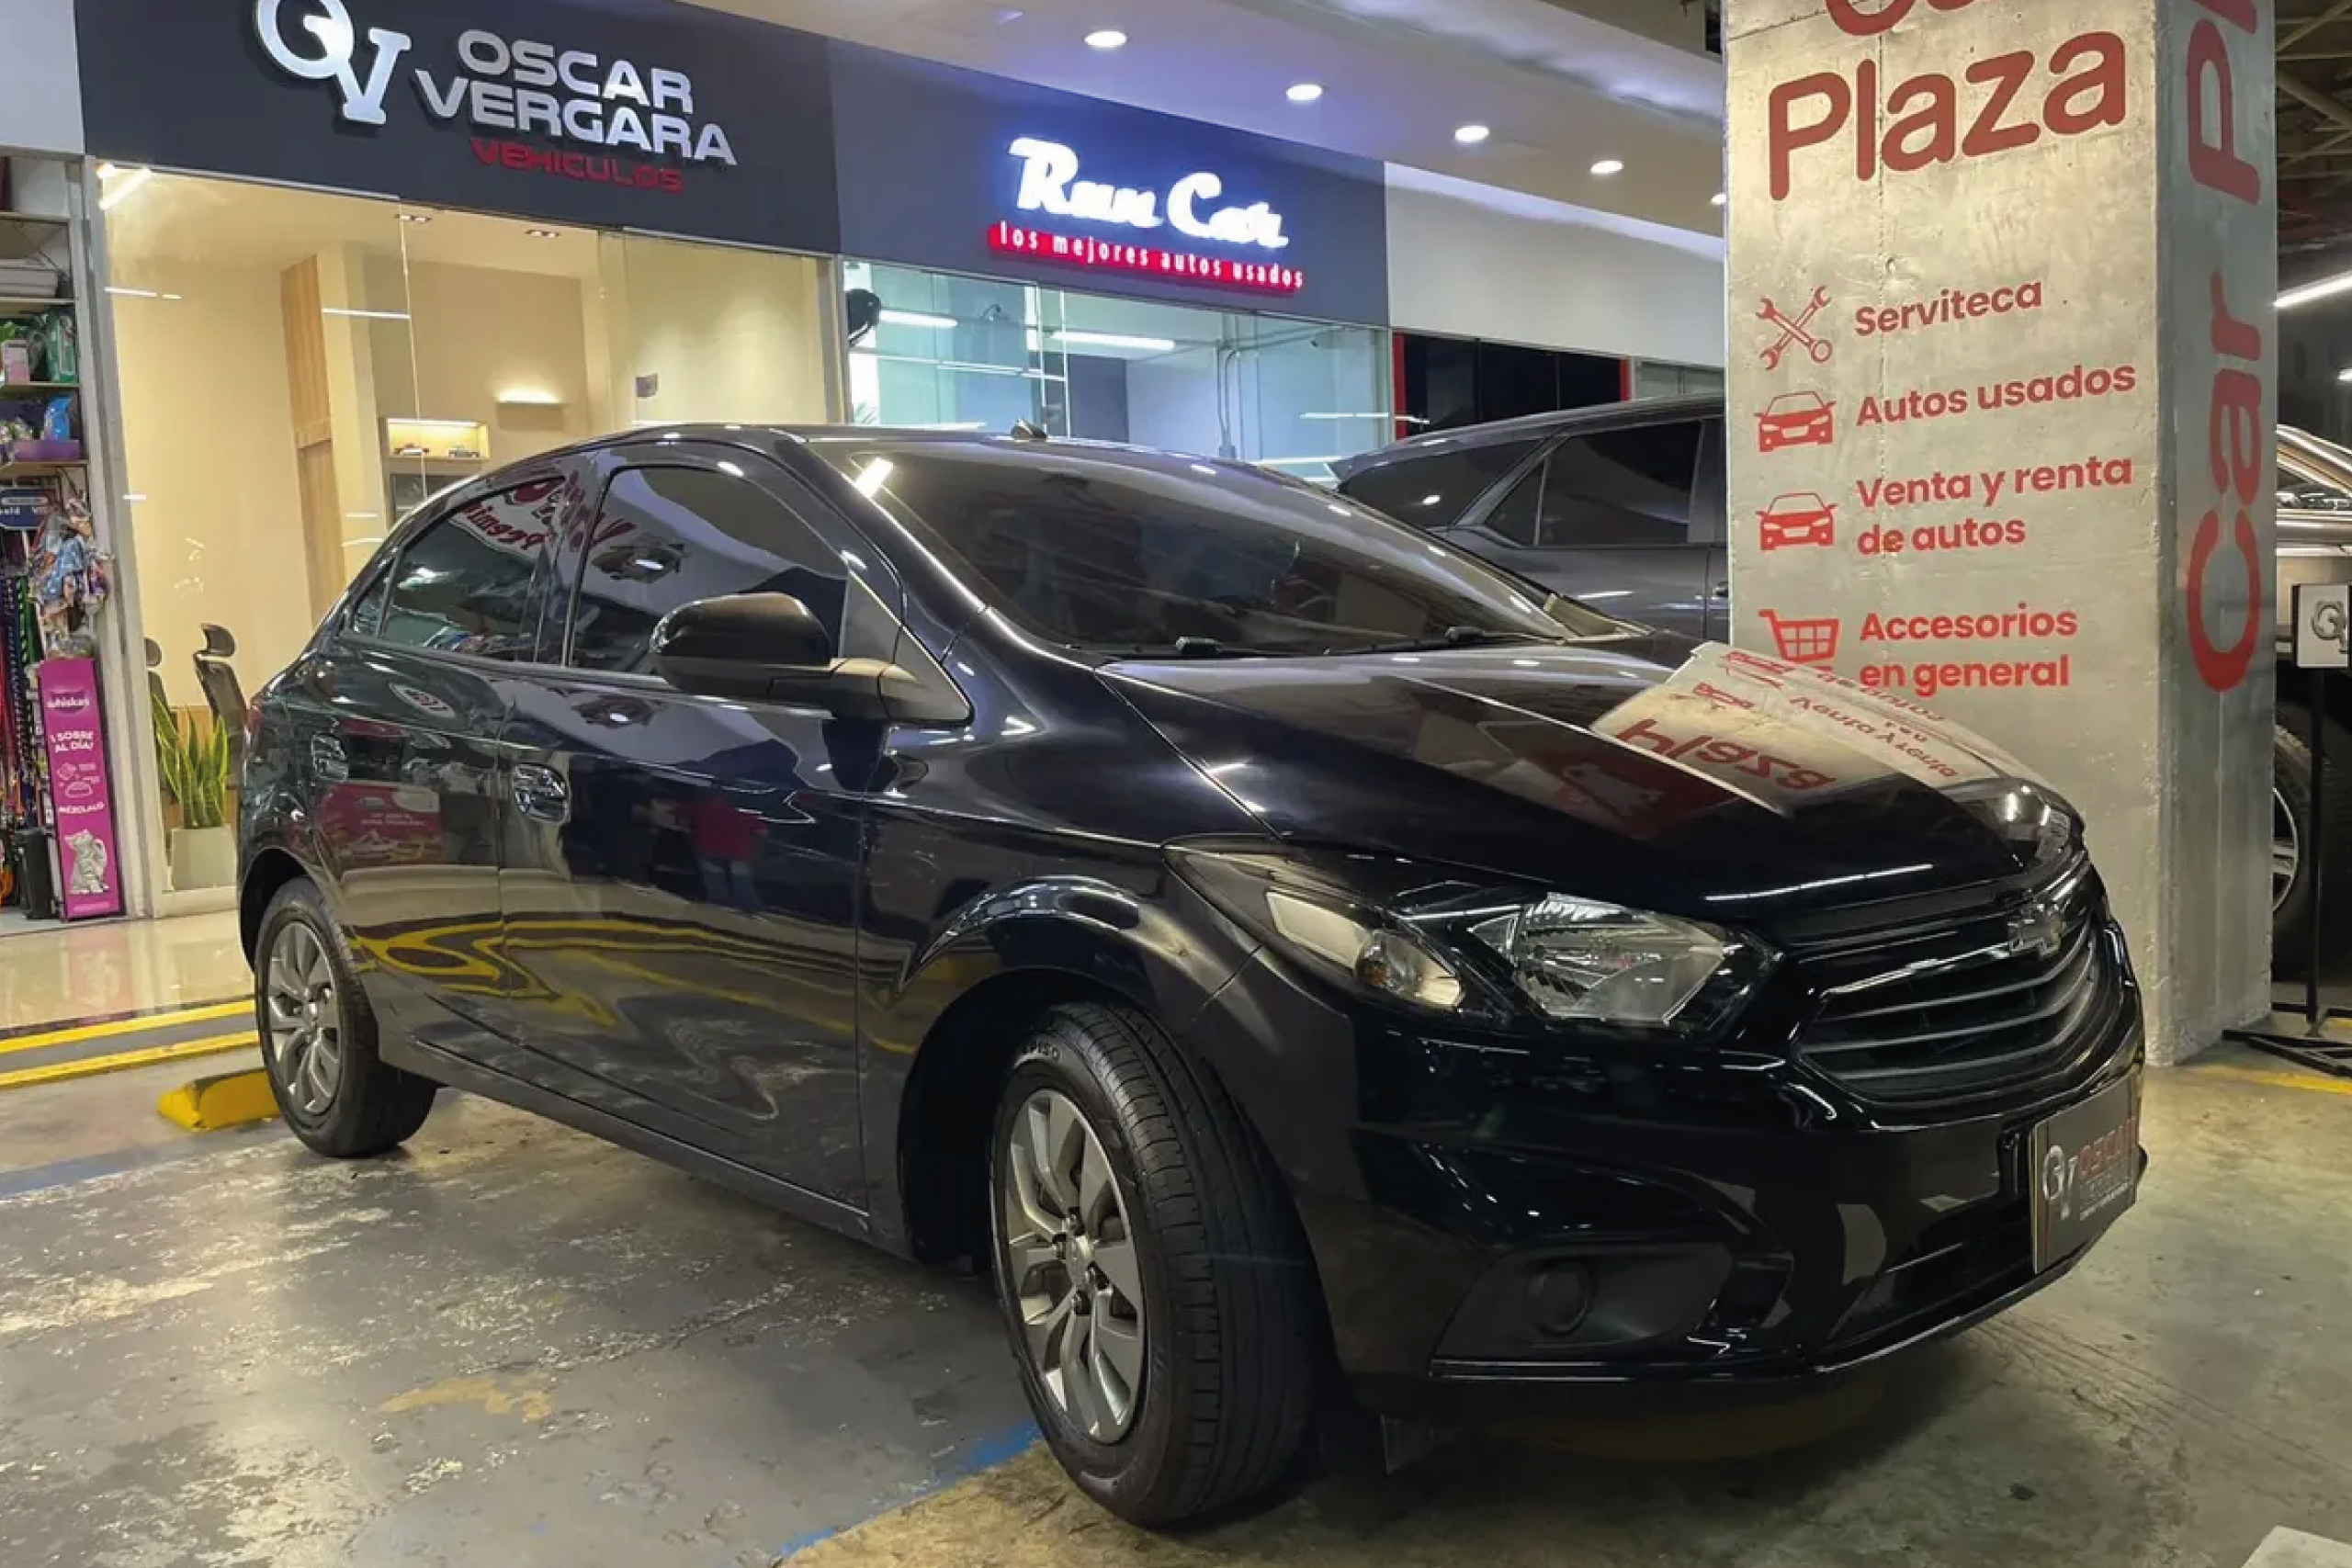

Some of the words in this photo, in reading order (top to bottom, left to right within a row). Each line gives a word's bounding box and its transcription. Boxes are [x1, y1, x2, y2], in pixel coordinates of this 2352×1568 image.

[458, 28, 693, 114] OSCAR
[414, 68, 737, 165] VERGARA
[1769, 30, 2126, 201] Plaza
[1009, 137, 1163, 229] Run
[1167, 172, 1289, 248] Car
[1000, 220, 1039, 251] los
[1053, 235, 1148, 265] mejores
[1160, 253, 1222, 276] autos
[1233, 263, 1303, 289] usados
[1854, 280, 2042, 336] Serviteca
[1856, 388, 1969, 426] Autos
[1976, 364, 2136, 410] usados
[1856, 471, 1972, 507] Venta
[1980, 471, 2007, 505] y
[2014, 455, 2133, 492] renta
[2186, 271, 2262, 694] Car
[1857, 523, 1905, 555] de
[1911, 514, 2026, 549] autos
[1859, 603, 2078, 641] Accesorios
[1859, 664, 1906, 687] en
[1913, 654, 2070, 697] general
